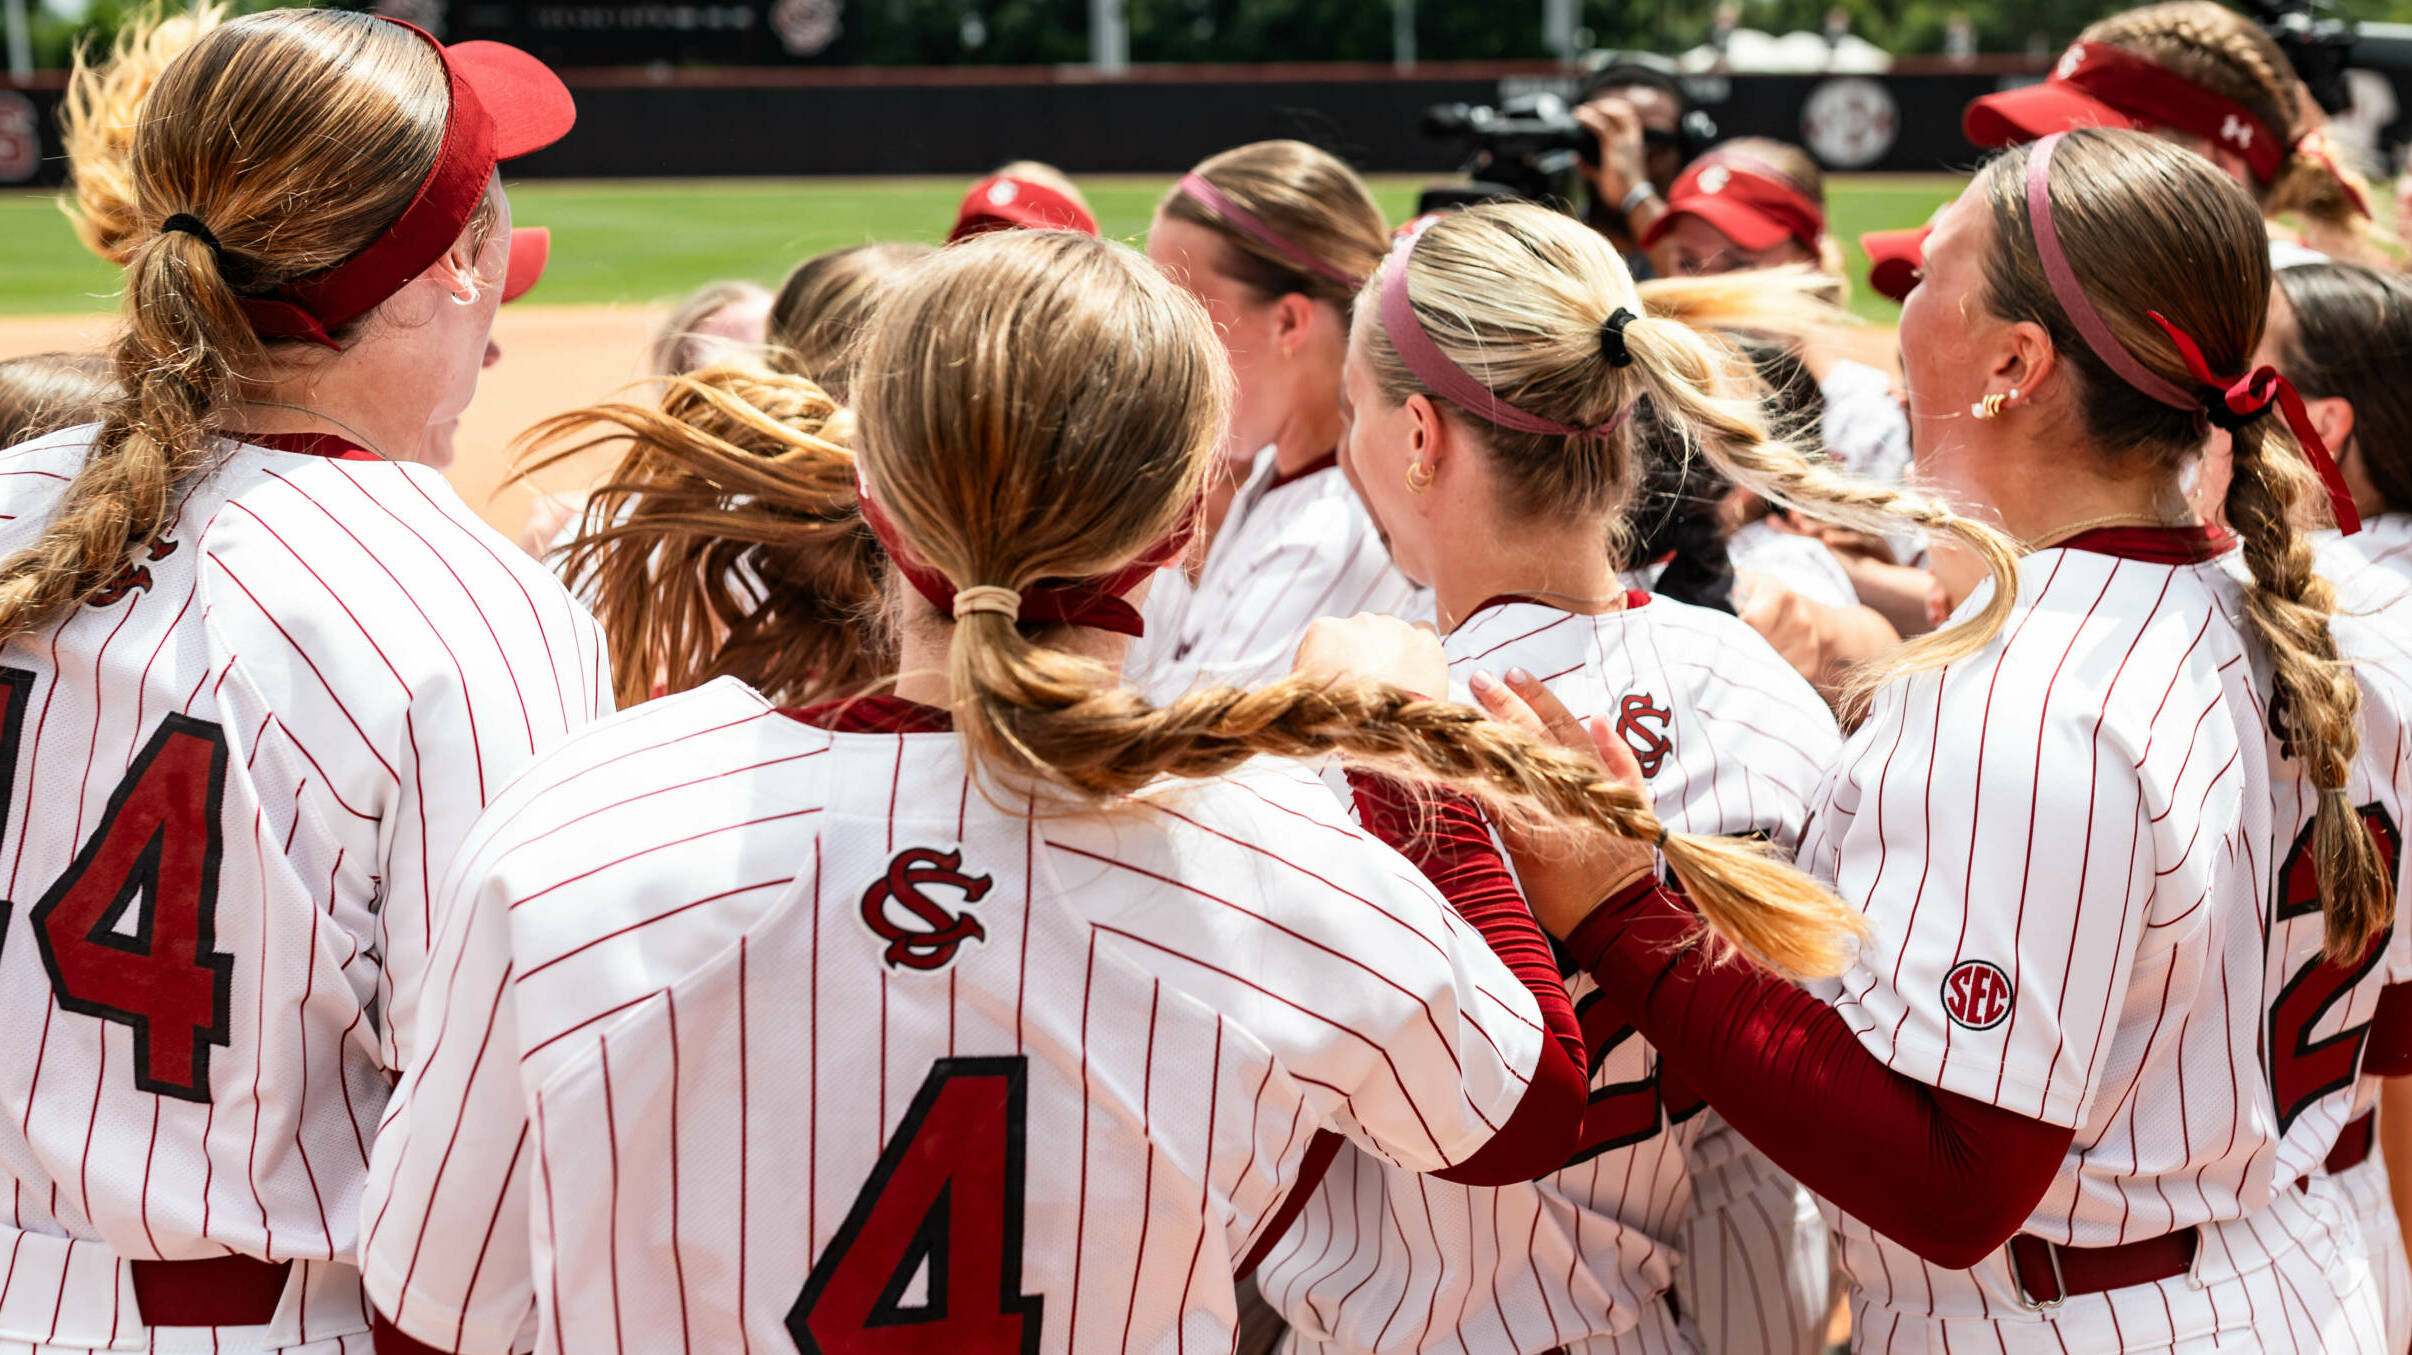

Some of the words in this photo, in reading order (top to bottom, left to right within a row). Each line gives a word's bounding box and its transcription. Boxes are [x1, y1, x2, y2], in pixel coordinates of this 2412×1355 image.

[0, 664, 233, 1103] 4
[1947, 964, 2008, 1025] SEC
[2257, 800, 2402, 1139] 2
[785, 1055, 1044, 1355] 4
